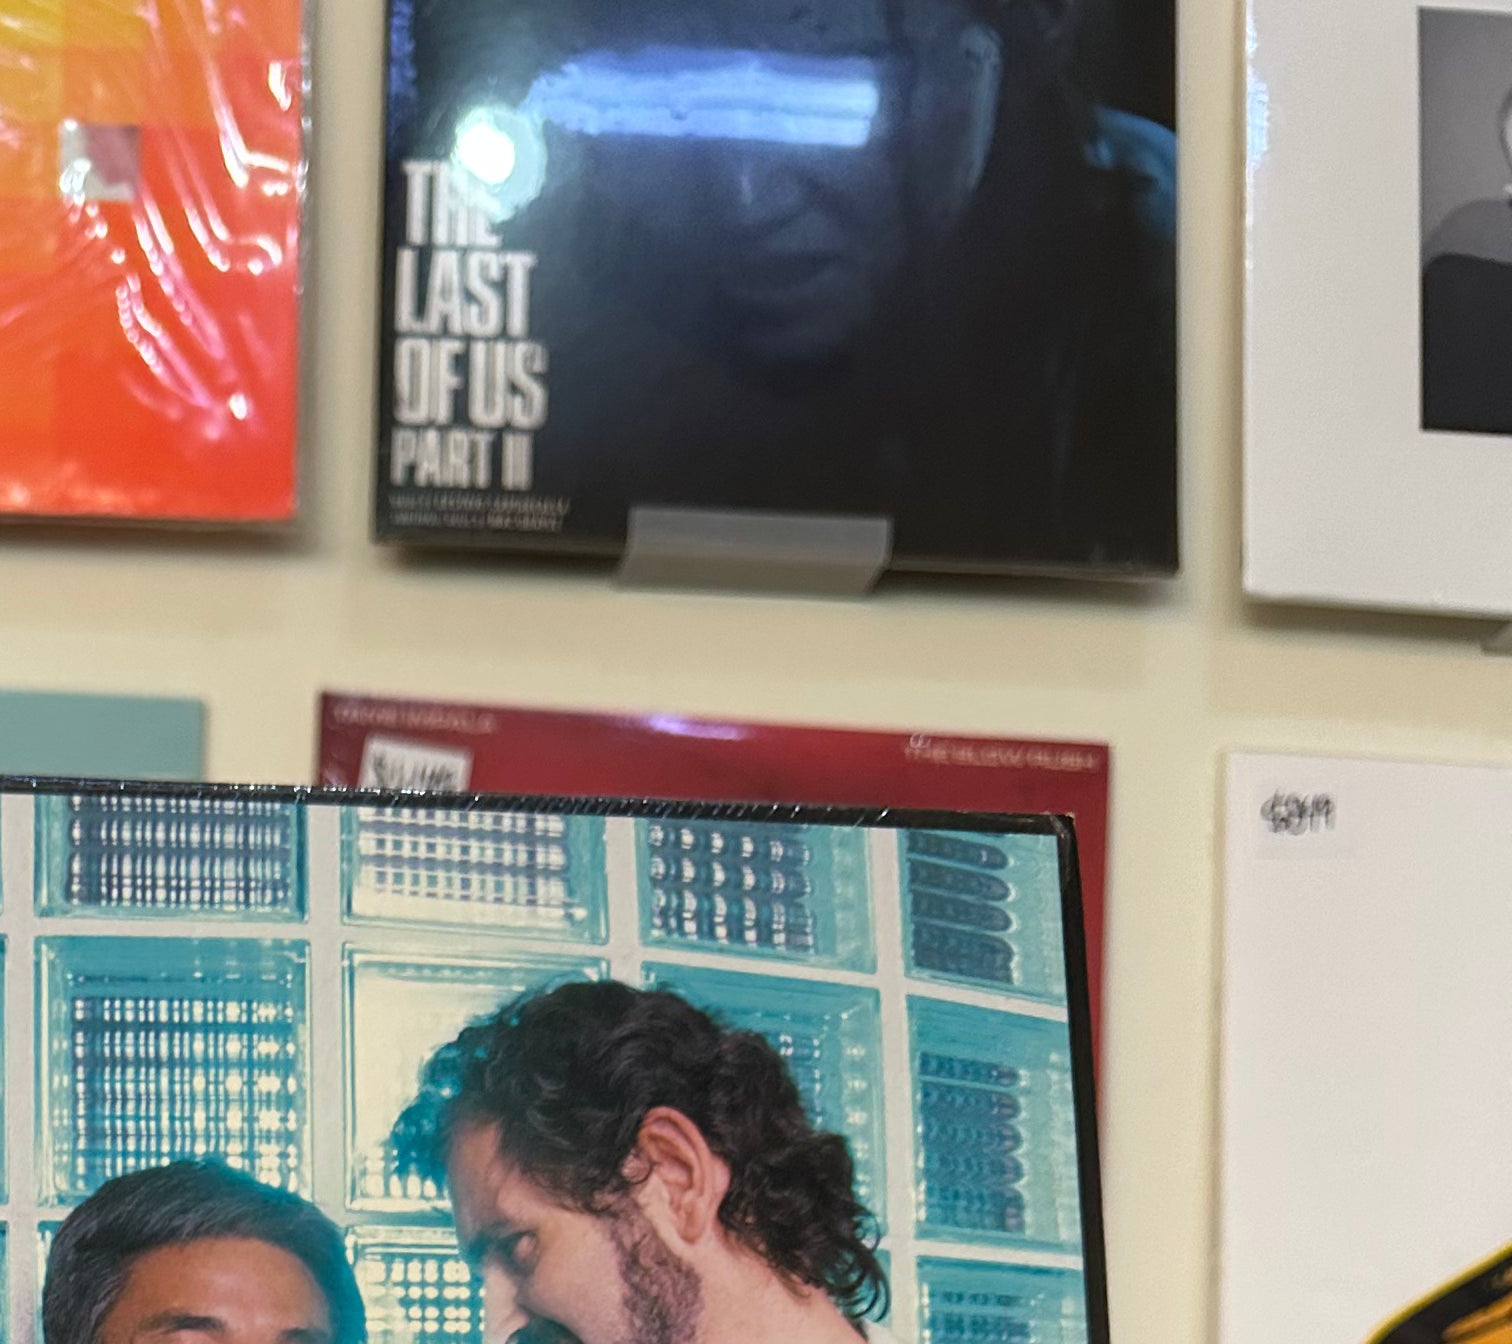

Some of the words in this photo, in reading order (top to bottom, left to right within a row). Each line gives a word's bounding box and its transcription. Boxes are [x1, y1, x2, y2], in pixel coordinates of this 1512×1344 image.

[393, 245, 538, 338] LAST
[394, 337, 464, 426] OF
[466, 339, 550, 431] US
[389, 427, 496, 488] PART
[501, 431, 535, 492] II
